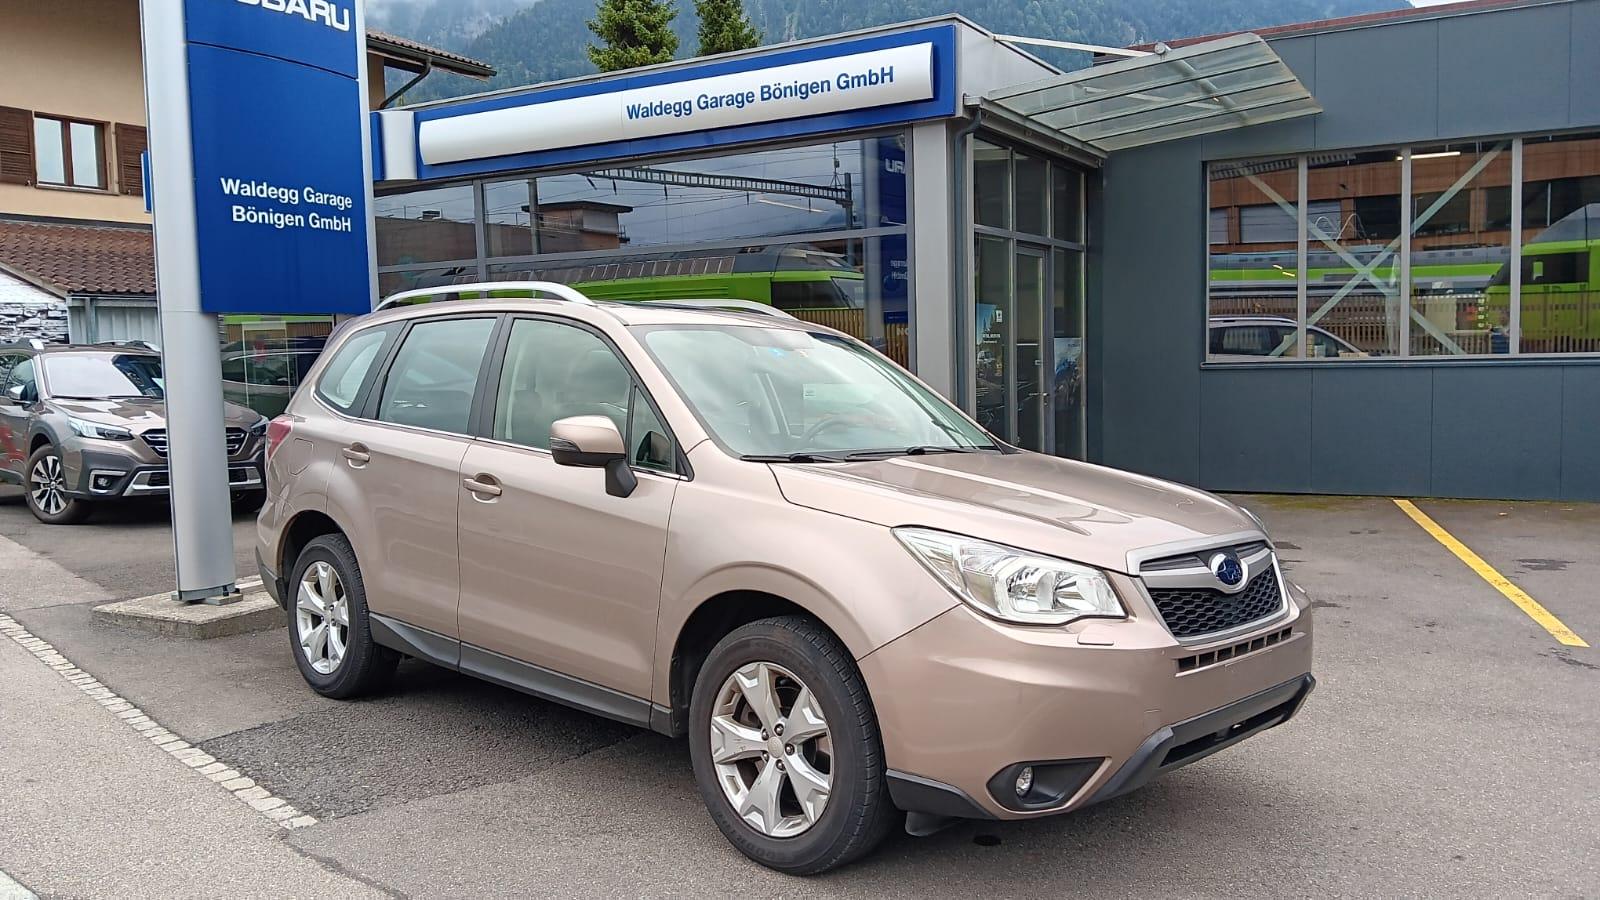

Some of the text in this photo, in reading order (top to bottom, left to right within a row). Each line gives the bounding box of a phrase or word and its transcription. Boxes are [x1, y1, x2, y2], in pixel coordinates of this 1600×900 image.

[626, 66, 893, 120] Waldegg Garage Bönigen GmbH
[220, 177, 352, 209] Waldegg Garage
[232, 205, 352, 233] Bönigen GmbH
